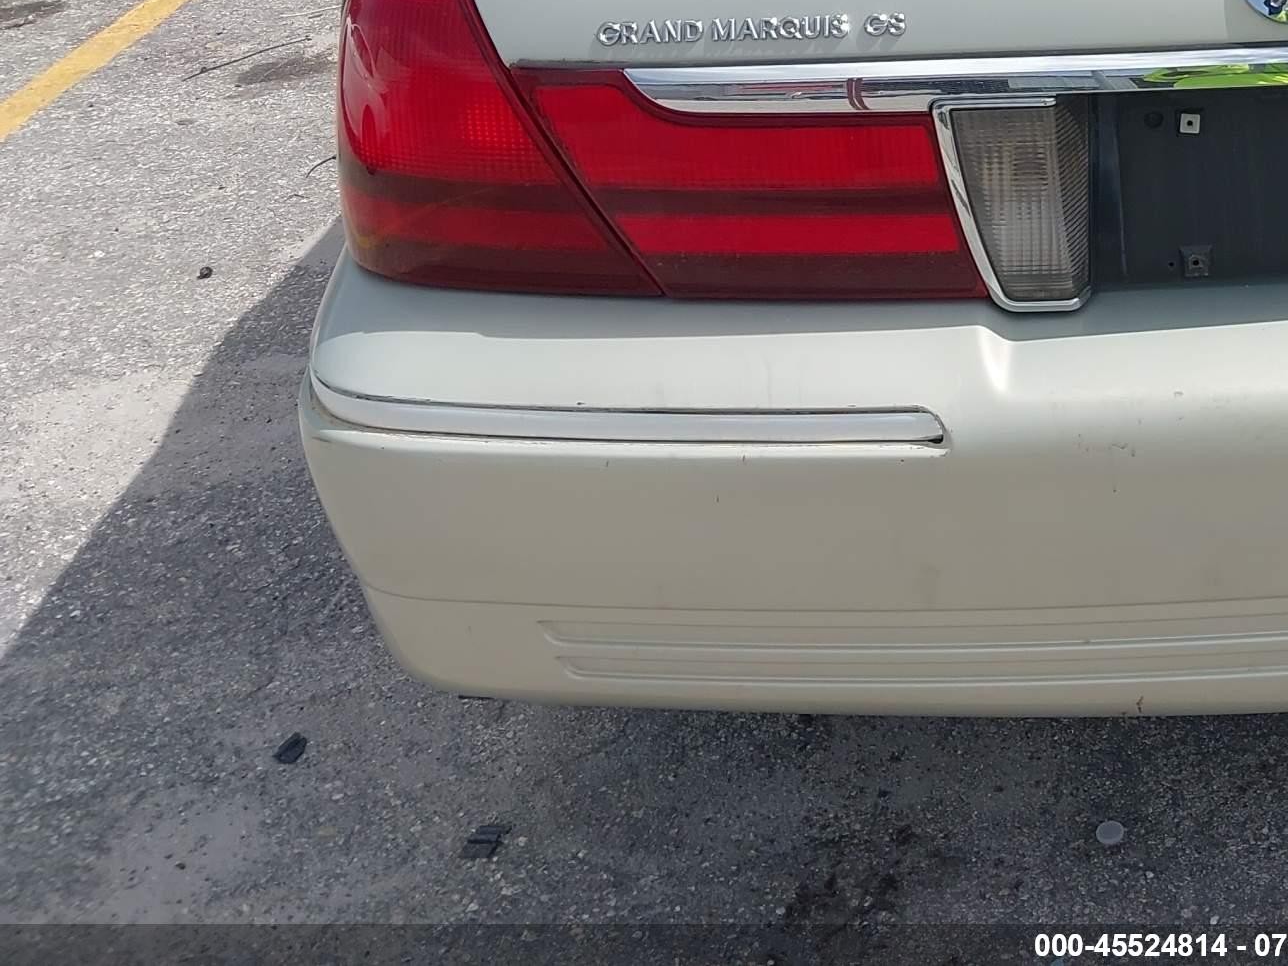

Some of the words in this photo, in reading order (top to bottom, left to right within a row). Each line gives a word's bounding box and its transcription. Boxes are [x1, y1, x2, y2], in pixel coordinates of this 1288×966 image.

[597, 18, 703, 46] GRAND
[710, 12, 850, 42] MARQUIS
[864, 10, 907, 36] GS
